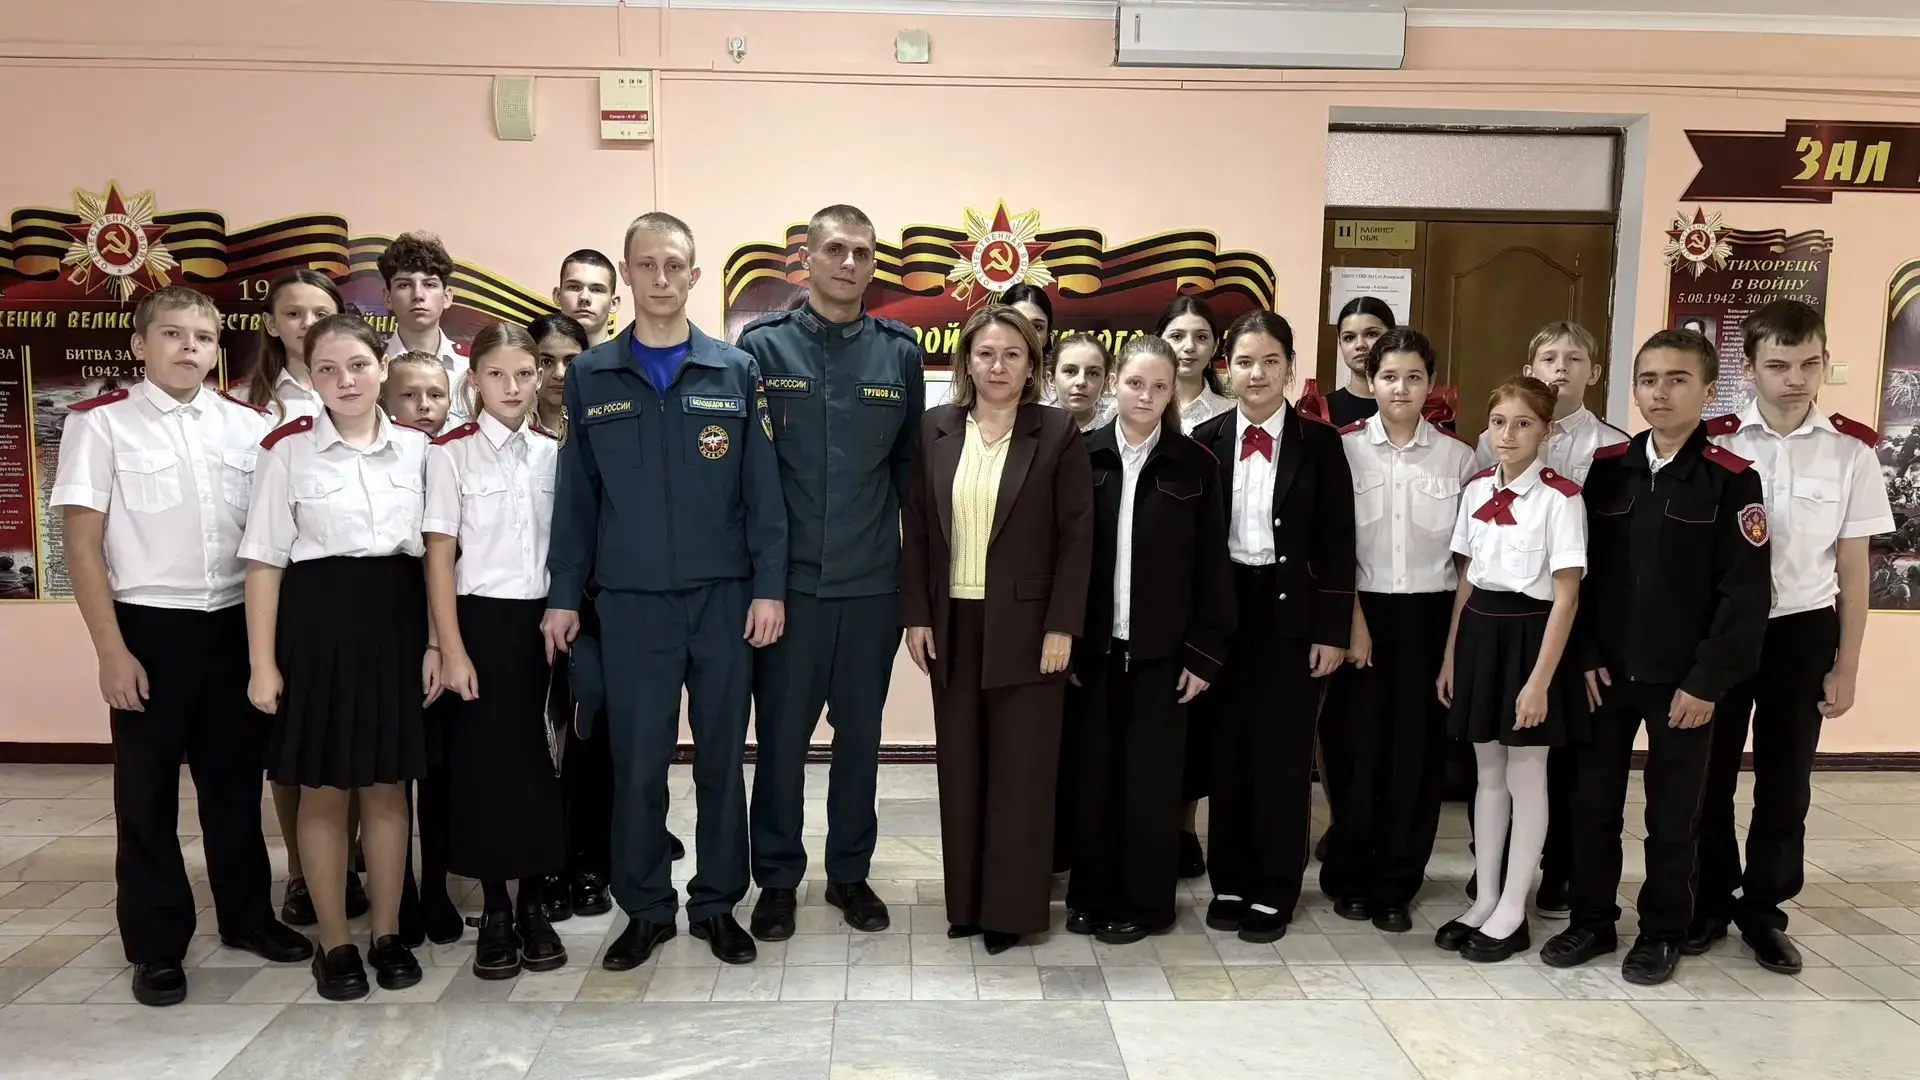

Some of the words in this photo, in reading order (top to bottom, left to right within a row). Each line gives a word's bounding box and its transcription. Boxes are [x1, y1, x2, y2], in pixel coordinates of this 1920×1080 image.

[1792, 137, 1892, 184] ЗАЛ
[1339, 226, 1351, 237] 11
[1360, 226, 1395, 234] КАБИНЕТ
[88, 215, 140, 270] ОТЕЧЕСТВЕННАЯ
[129, 235, 147, 270] ВОЙНА
[1360, 234, 1379, 242] ОБЖ
[973, 232, 1023, 286] ОТЕЧЕСТВЕННАЯ
[1010, 252, 1028, 285] ВОЙНА
[1727, 259, 1822, 273] ТИХОРЕЦК
[1731, 278, 1744, 290] В
[1748, 276, 1809, 291] ВОЙНУ
[1676, 293, 1735, 304] 5.08.1942
[67, 311, 137, 329] ВЕЛИК
[65, 349, 112, 360] БИТВА
[115, 349, 132, 360] ЗА
[81, 365, 120, 379] (1942
[765, 379, 780, 388] МЧС
[780, 379, 807, 389] РОССИИ
[863, 388, 889, 398] ТРУШОВ
[587, 406, 603, 416] МЧС
[603, 401, 632, 413] РОССИИ
